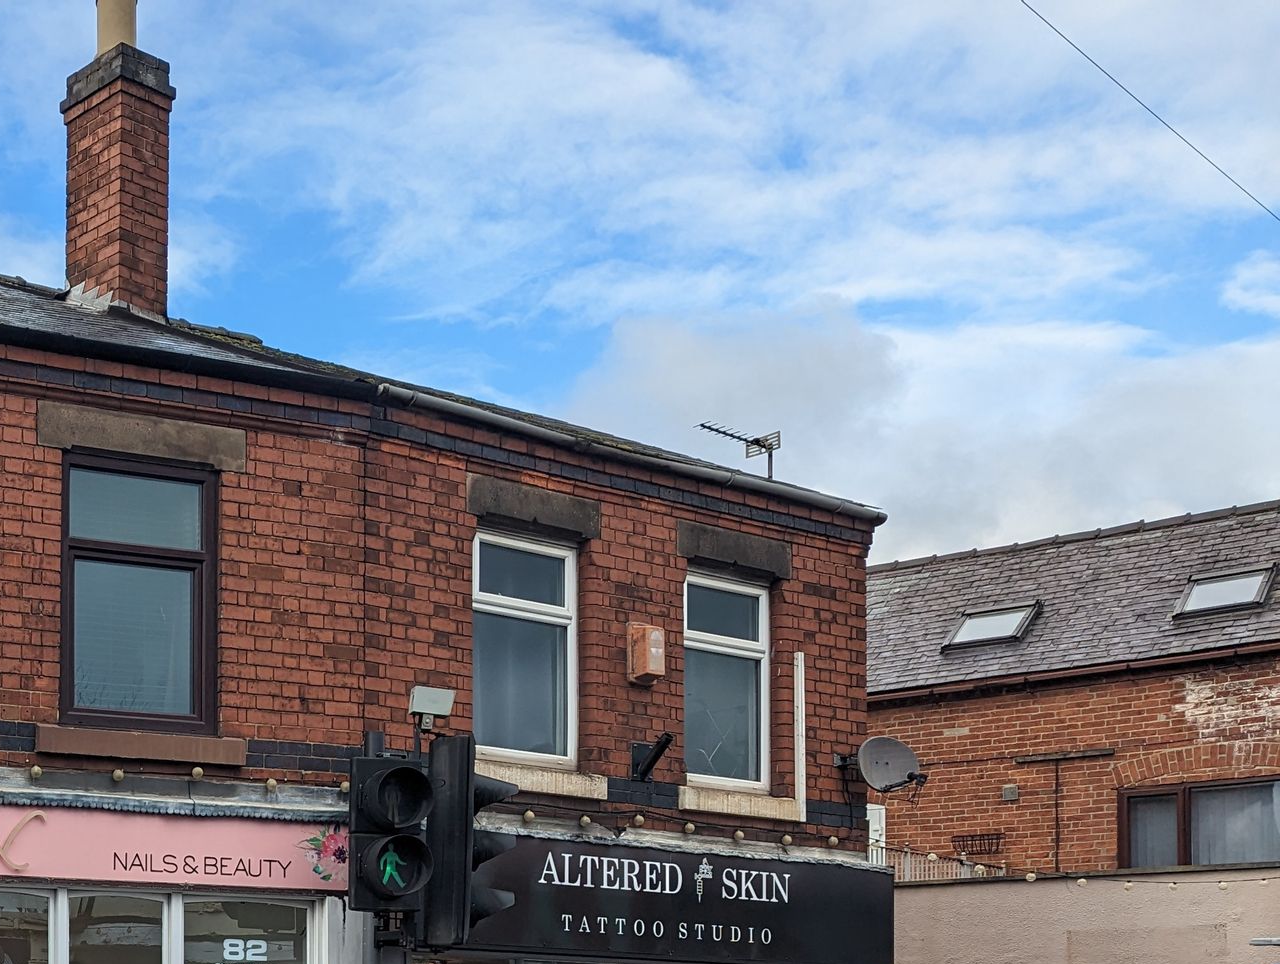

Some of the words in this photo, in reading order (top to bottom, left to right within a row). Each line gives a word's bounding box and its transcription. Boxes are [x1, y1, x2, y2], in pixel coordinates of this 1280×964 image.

[112, 852, 179, 874] NAILS
[182, 855, 199, 875] &
[203, 856, 292, 879] BEAUTY
[538, 851, 683, 895] ALTERED
[722, 868, 791, 904] SKIN
[562, 914, 664, 938] TATTOO
[678, 922, 772, 945] STUDIO
[222, 938, 268, 962] 82
